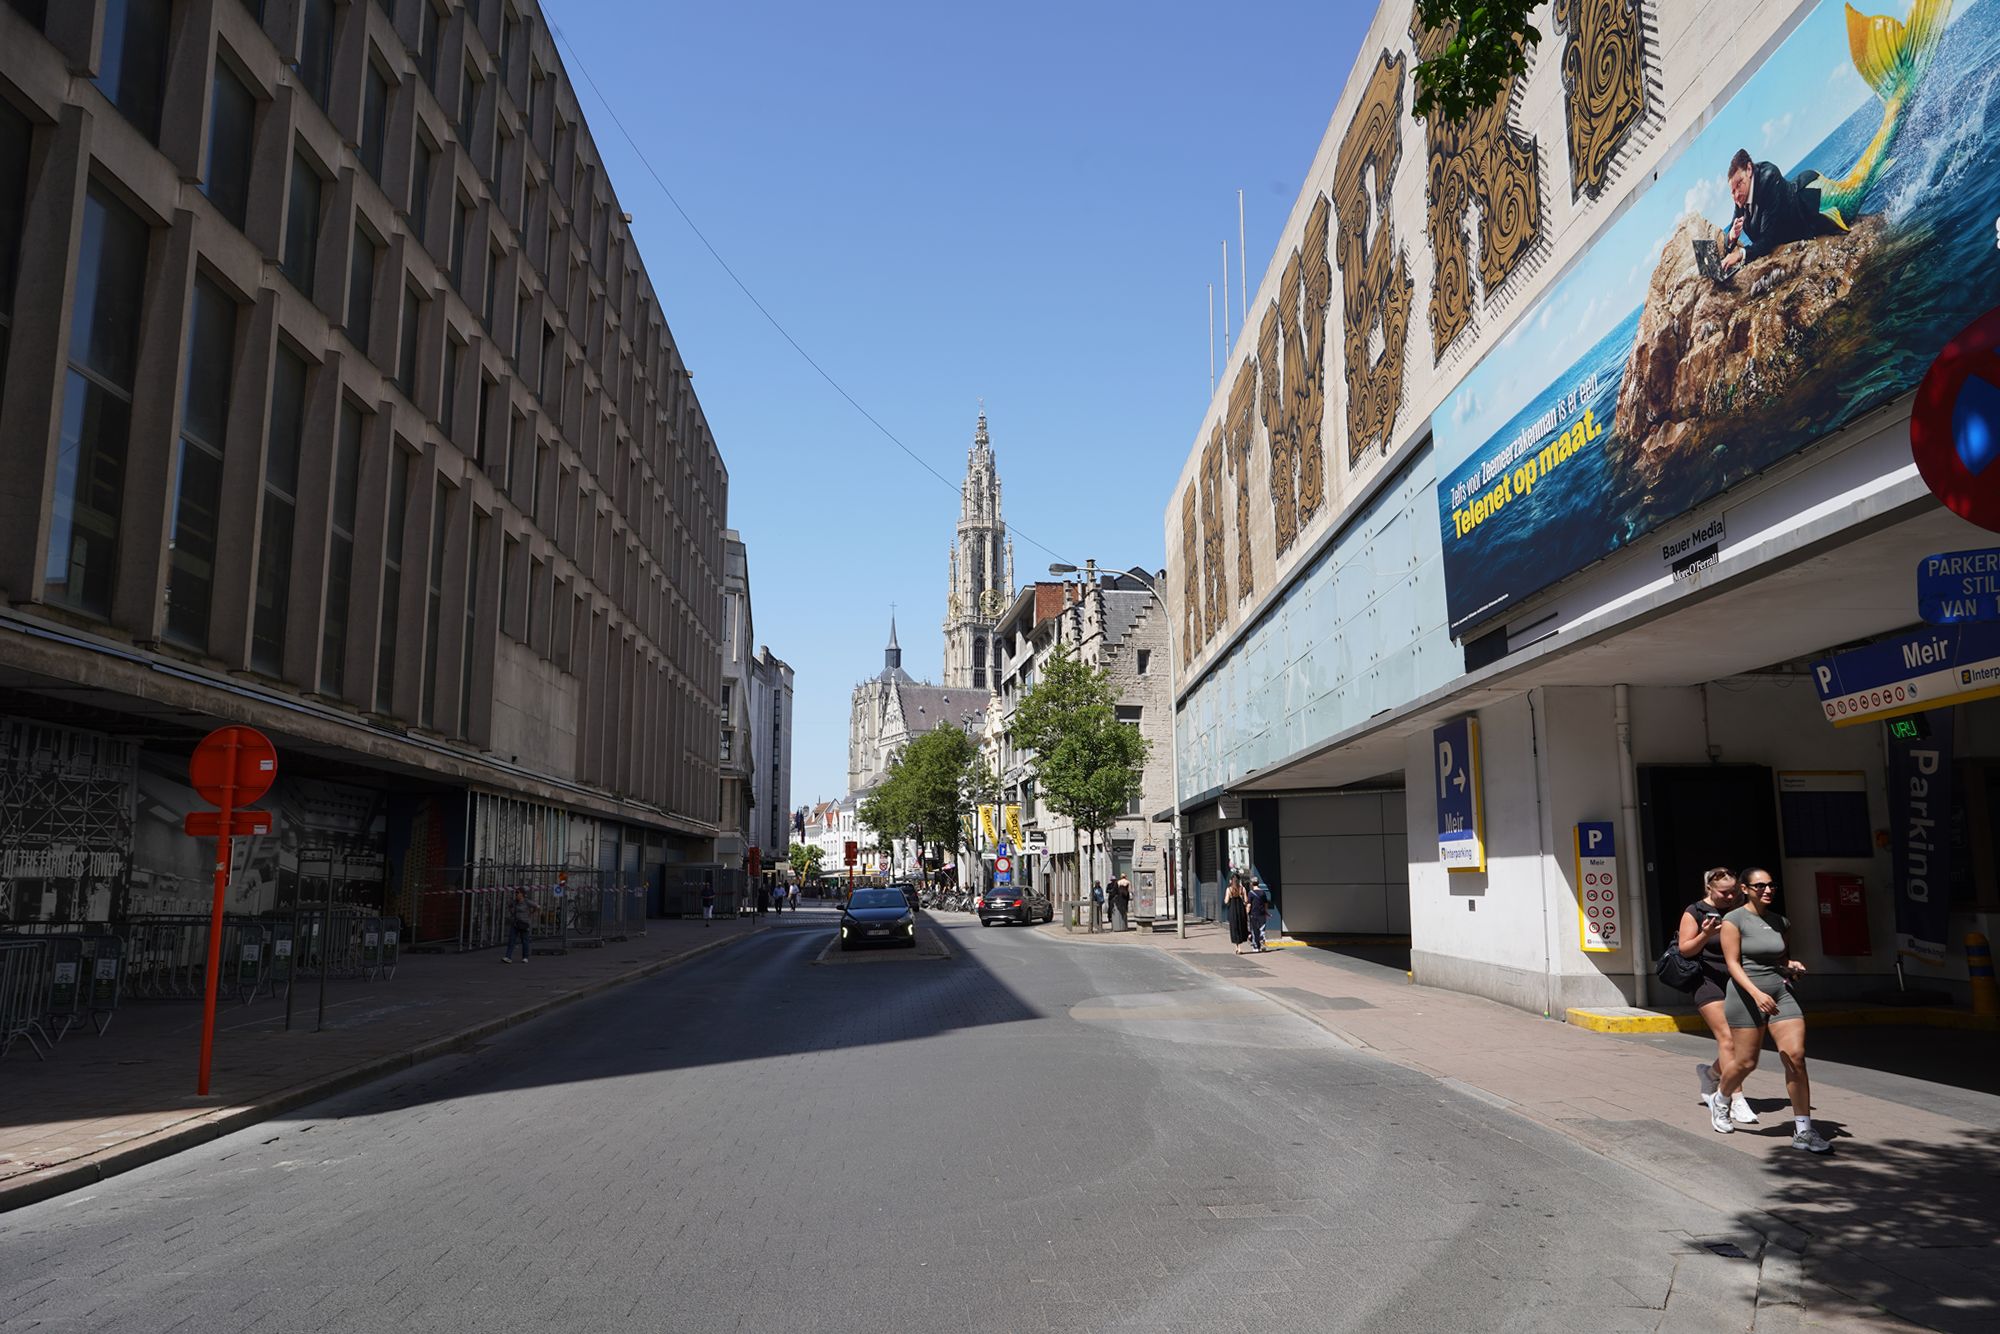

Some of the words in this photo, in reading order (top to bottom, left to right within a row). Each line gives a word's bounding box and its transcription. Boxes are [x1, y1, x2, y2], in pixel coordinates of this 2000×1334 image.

[1450, 477, 1467, 510] Zelfs
[1467, 470, 1481, 497] voor
[1481, 407, 1557, 484] Zeemeerzakenman
[1557, 399, 1567, 422] is
[1568, 390, 1578, 414] er
[1580, 373, 1598, 404] een
[1452, 474, 1512, 539] Telenet
[1513, 459, 1537, 496] op
[1540, 408, 1602, 476] maat.
[1662, 537, 1691, 560] Bauer
[1692, 520, 1724, 546] Media
[1672, 568, 1690, 583] More
[1689, 552, 1719, 574] O'Ferrall
[1928, 553, 2000, 577] PARKER
[1941, 598, 1977, 618] VAN
[1816, 665, 1832, 694] P
[1902, 636, 1949, 669] Meir
[1439, 740, 1453, 799] P
[1445, 812, 1464, 834] Meir
[1588, 829, 1602, 849] P
[1906, 749, 1940, 903] Parking
